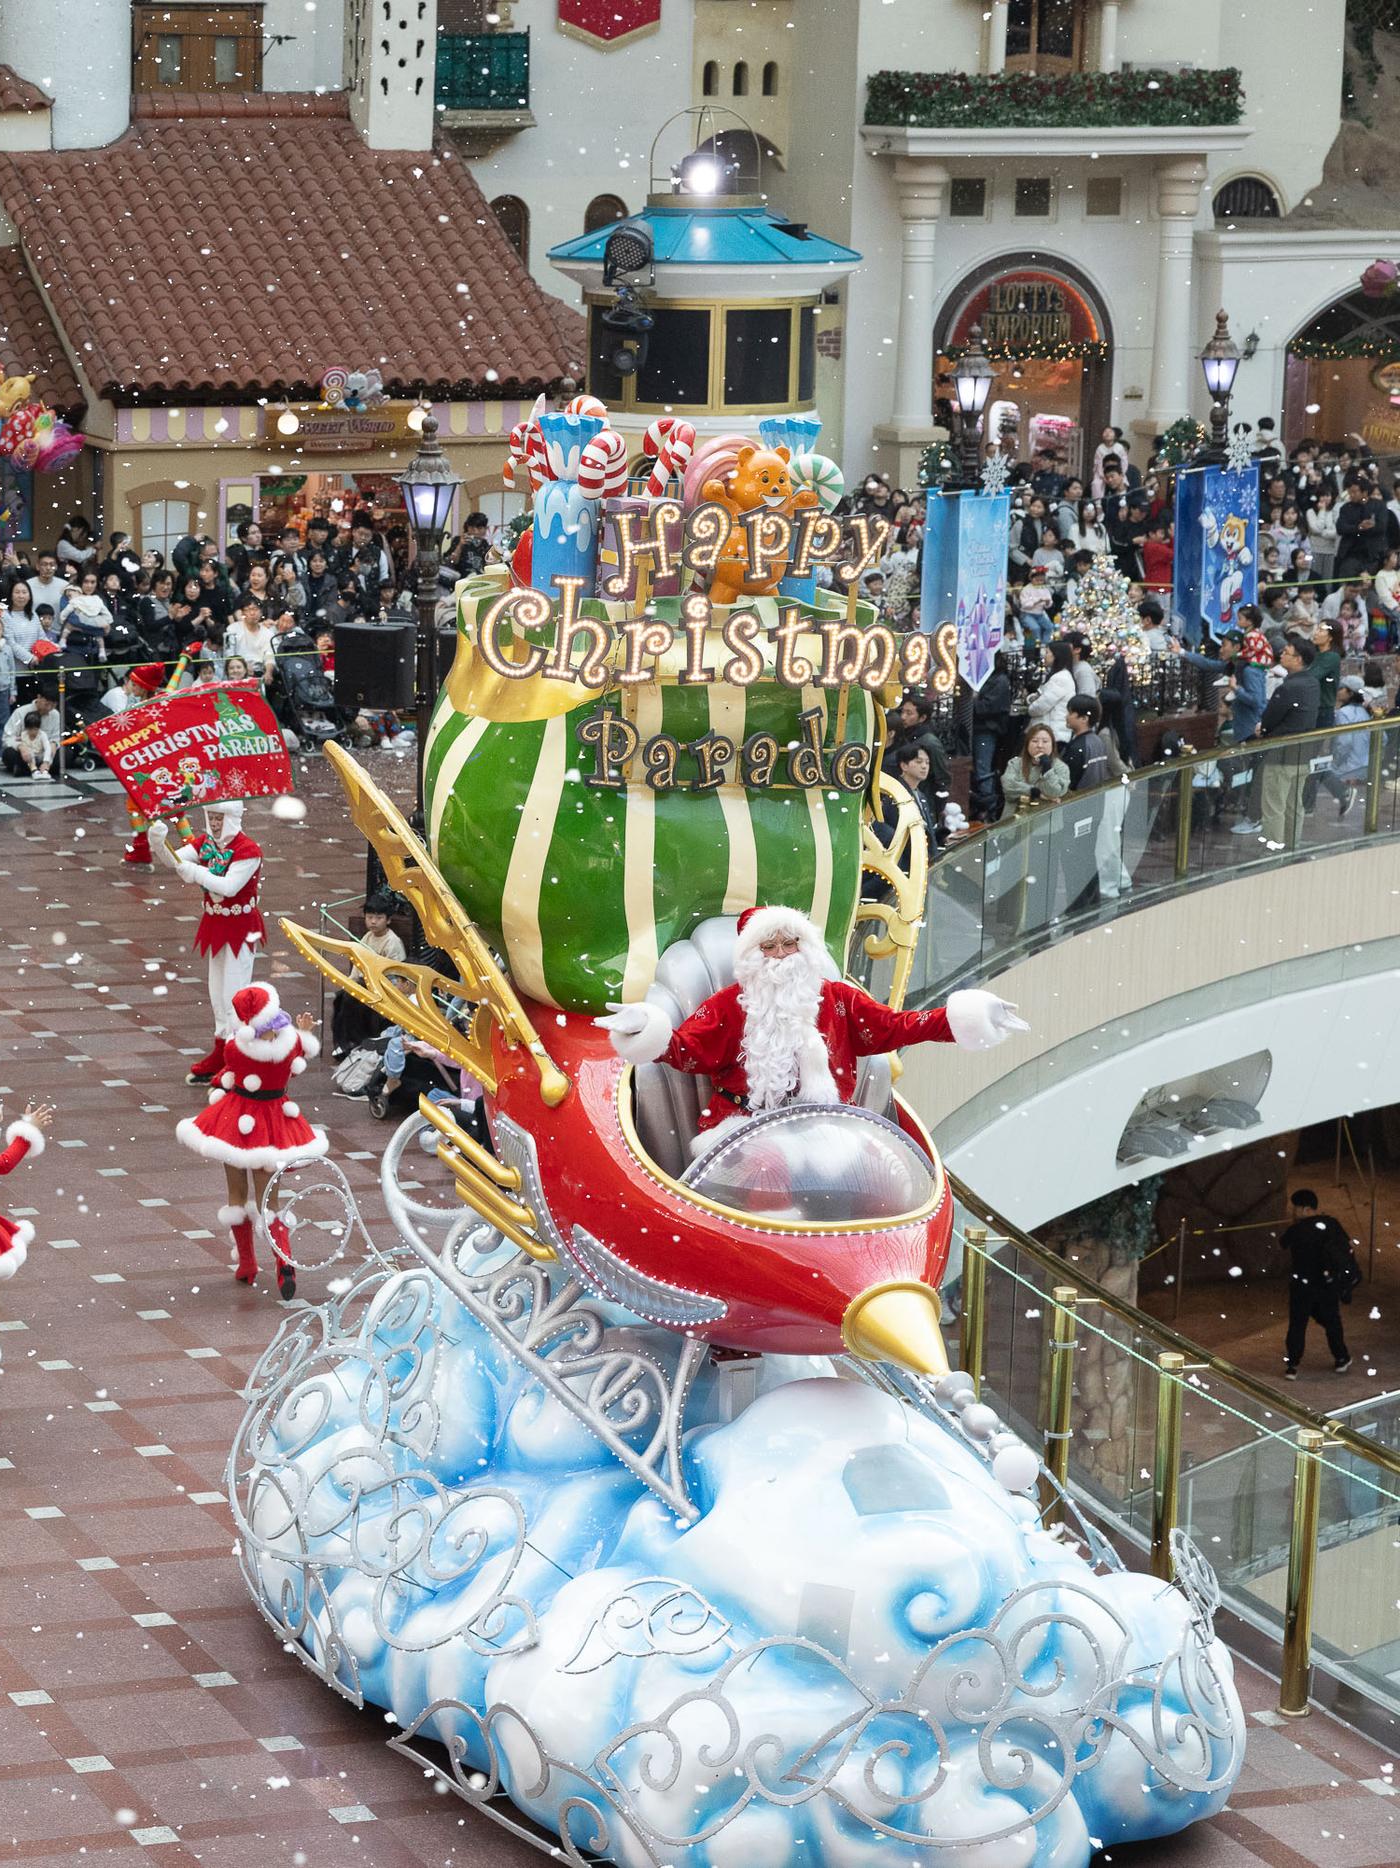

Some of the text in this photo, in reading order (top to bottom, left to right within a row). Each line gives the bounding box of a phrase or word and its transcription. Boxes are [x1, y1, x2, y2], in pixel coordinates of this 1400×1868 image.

[346, 418, 395, 434] WORLD
[604, 500, 891, 597] Happy
[476, 574, 959, 694] Christmas
[108, 721, 162, 756] HAPPY
[203, 734, 282, 761] PARADE
[576, 705, 871, 793] Parade
